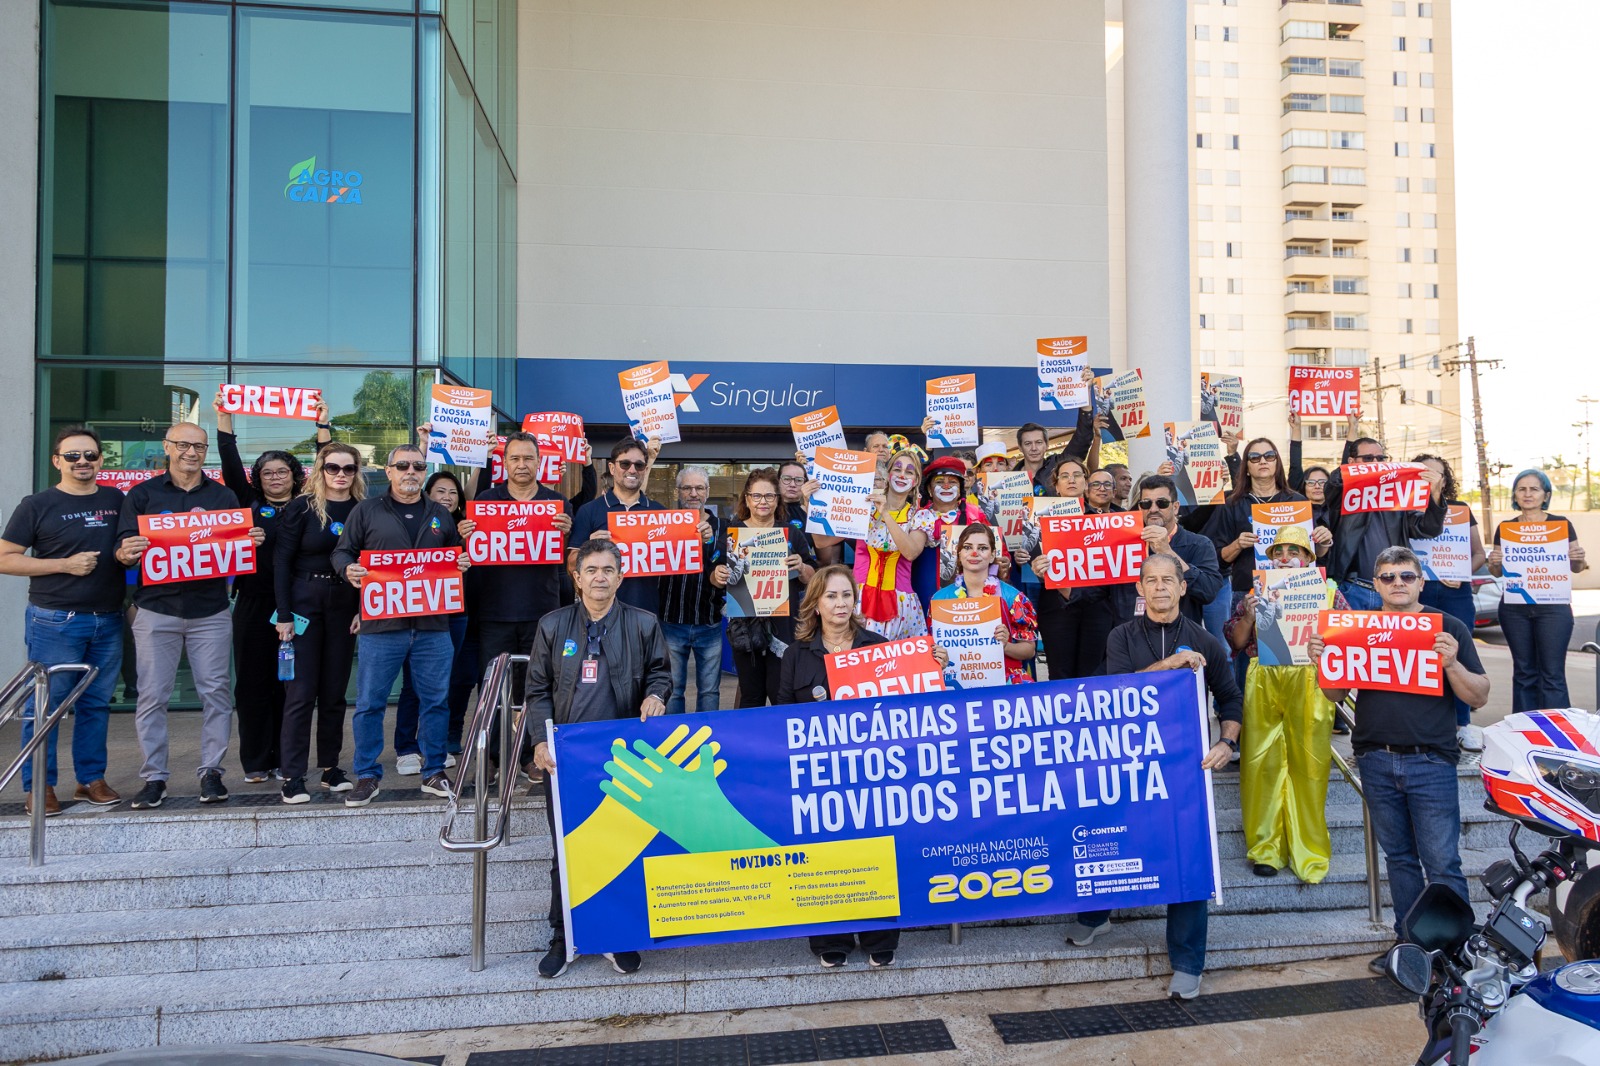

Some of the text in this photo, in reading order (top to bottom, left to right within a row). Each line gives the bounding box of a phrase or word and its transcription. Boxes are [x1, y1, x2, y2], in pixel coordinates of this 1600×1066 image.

[297, 169, 363, 186] AGRO
[289, 186, 362, 204] CAIXA
[632, 367, 652, 378] SAÚDE
[1294, 368, 1354, 379] ESTAMOS
[633, 378, 654, 387] CAIXA
[1314, 380, 1330, 390] EM
[451, 389, 474, 397] SAÚDE
[630, 388, 654, 402] NOSSA
[710, 382, 823, 412] Singular
[222, 384, 318, 418] GREVE
[627, 393, 671, 411] CONQUISTA!
[934, 396, 959, 405] NOSSA
[1117, 401, 1145, 411] PROPOSTA
[1289, 390, 1358, 415] GREVE
[442, 408, 471, 417] NOSSA
[642, 408, 657, 418] NÃO
[928, 402, 975, 412] CONQUISTA!
[1220, 404, 1242, 412] PROPOSTA
[434, 415, 488, 427] CONQUISTA!
[529, 414, 582, 426] ESTAMOS
[643, 413, 674, 426] ABRIMOS
[1121, 408, 1143, 428] JÁ!
[1221, 411, 1240, 427] JÁ!
[452, 428, 470, 437] NÃO
[803, 430, 827, 442] NOSSA
[450, 436, 486, 446] ABRIMOS
[800, 433, 842, 450] CONQUISTA!
[450, 444, 472, 452] MÃO.
[834, 452, 858, 461] SAÚDE
[832, 463, 857, 472] CAIXA
[823, 474, 853, 484] NOSSA
[1194, 468, 1218, 489] JÁ!
[1379, 471, 1398, 483] EM
[832, 496, 852, 505] NÃO
[1343, 479, 1430, 512] GREVE
[475, 504, 557, 516] ESTAMOS
[831, 507, 868, 516] ABRIMOS
[1053, 507, 1080, 515] PALHAÇOS
[1270, 505, 1294, 513] SAÚDE
[62, 511, 92, 520] TOMMY
[148, 512, 244, 531] ESTAMOS
[616, 512, 694, 526] ESTAMOS
[830, 513, 854, 523] MÃO.
[507, 517, 528, 530] EM
[1049, 514, 1135, 532] ESTAMOS
[190, 528, 213, 543] EM
[648, 526, 668, 540] EM
[1083, 531, 1105, 546] EM
[468, 530, 561, 562] GREVE
[758, 537, 784, 546] PALHAÇOS
[1432, 544, 1451, 552] NÃO
[144, 540, 254, 582] GREVE
[370, 550, 455, 566] ESTAMOS
[617, 540, 700, 574] GREVE
[1046, 544, 1142, 582] GREVE
[1505, 554, 1567, 563] CONQUISTA!
[403, 564, 424, 579] EM
[1527, 566, 1548, 574] NÃO
[753, 577, 783, 599] JÁ!
[1289, 578, 1322, 588] PALHAÇOS
[1528, 581, 1553, 590] MÃO.
[363, 578, 461, 616] GREVE
[952, 601, 979, 610] SAÚDE
[1328, 613, 1432, 631] ESTAMOS
[944, 628, 979, 637] NOSSA
[1367, 631, 1393, 646] EM
[834, 639, 929, 668] ESTAMOS
[960, 652, 981, 661] NÃO
[875, 659, 897, 678] EM
[960, 662, 1002, 671] ABRIMOS
[1320, 644, 1439, 689] GREVE
[961, 671, 987, 680] MÃO.
[786, 684, 1160, 749] BANCÁRIAS E BANCÁRIOS
[789, 721, 1166, 788] FEITOS DE ESPERANÇA
[791, 760, 1169, 834] MOVIDOS PELA LUTA
[922, 836, 1048, 858] CAMPANHA NACIONAL
[730, 852, 809, 870] MOVIDOS POR:
[952, 848, 1050, 866] D@S BANCÁRI@S
[656, 883, 694, 892] Manutenção
[928, 864, 1053, 903] 2026
[656, 889, 698, 898] conquistados
[704, 885, 750, 894] fortalecimento
[796, 894, 833, 902] Distribuição
[853, 895, 896, 903] trabalhadores
